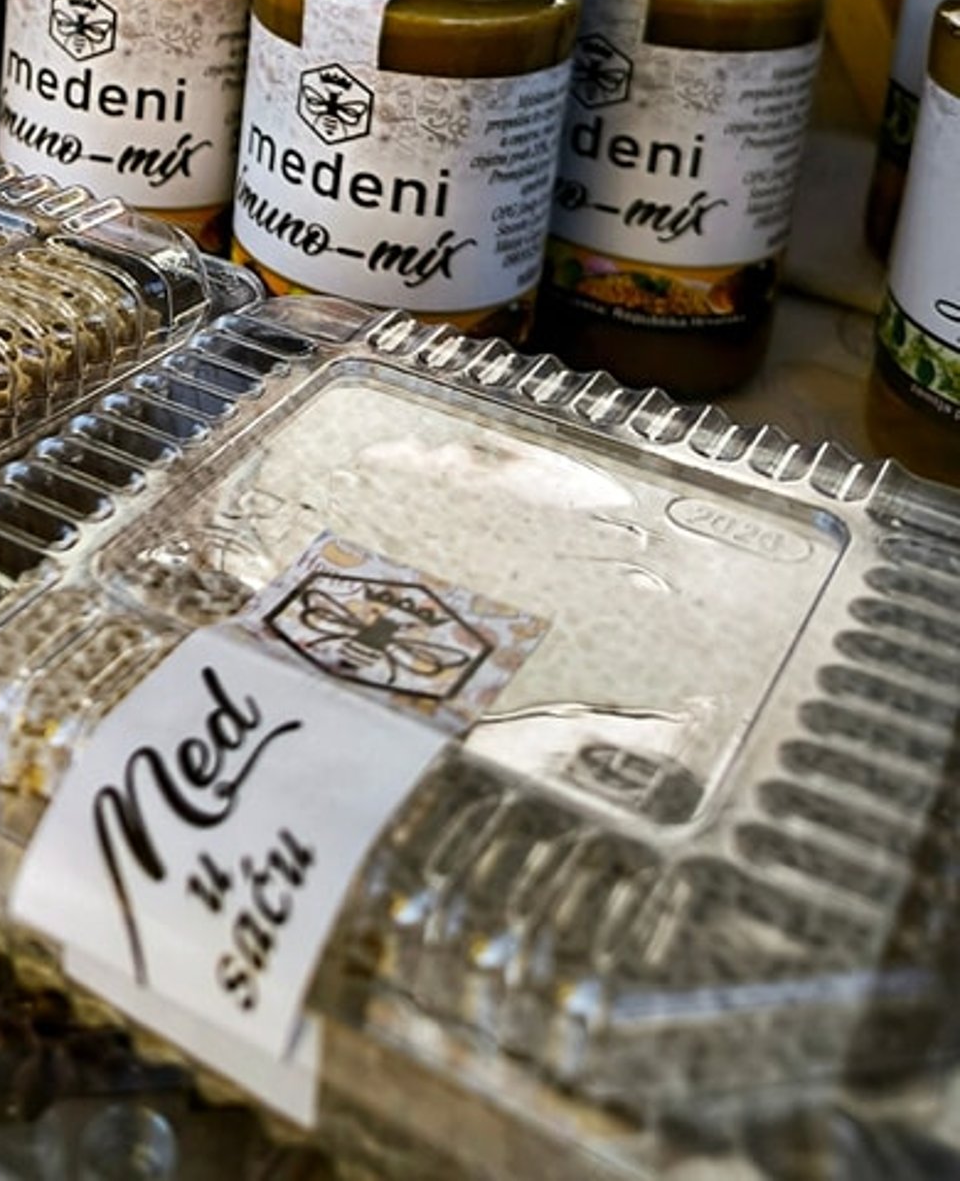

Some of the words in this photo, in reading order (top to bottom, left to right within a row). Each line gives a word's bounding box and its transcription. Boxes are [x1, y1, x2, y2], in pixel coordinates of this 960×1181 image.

[7, 49, 187, 122] medeni
[248, 122, 450, 217] medeni
[571, 115, 705, 178] deni
[554, 177, 730, 244] o-mix
[93, 666, 304, 990] Med
[186, 851, 234, 914] u
